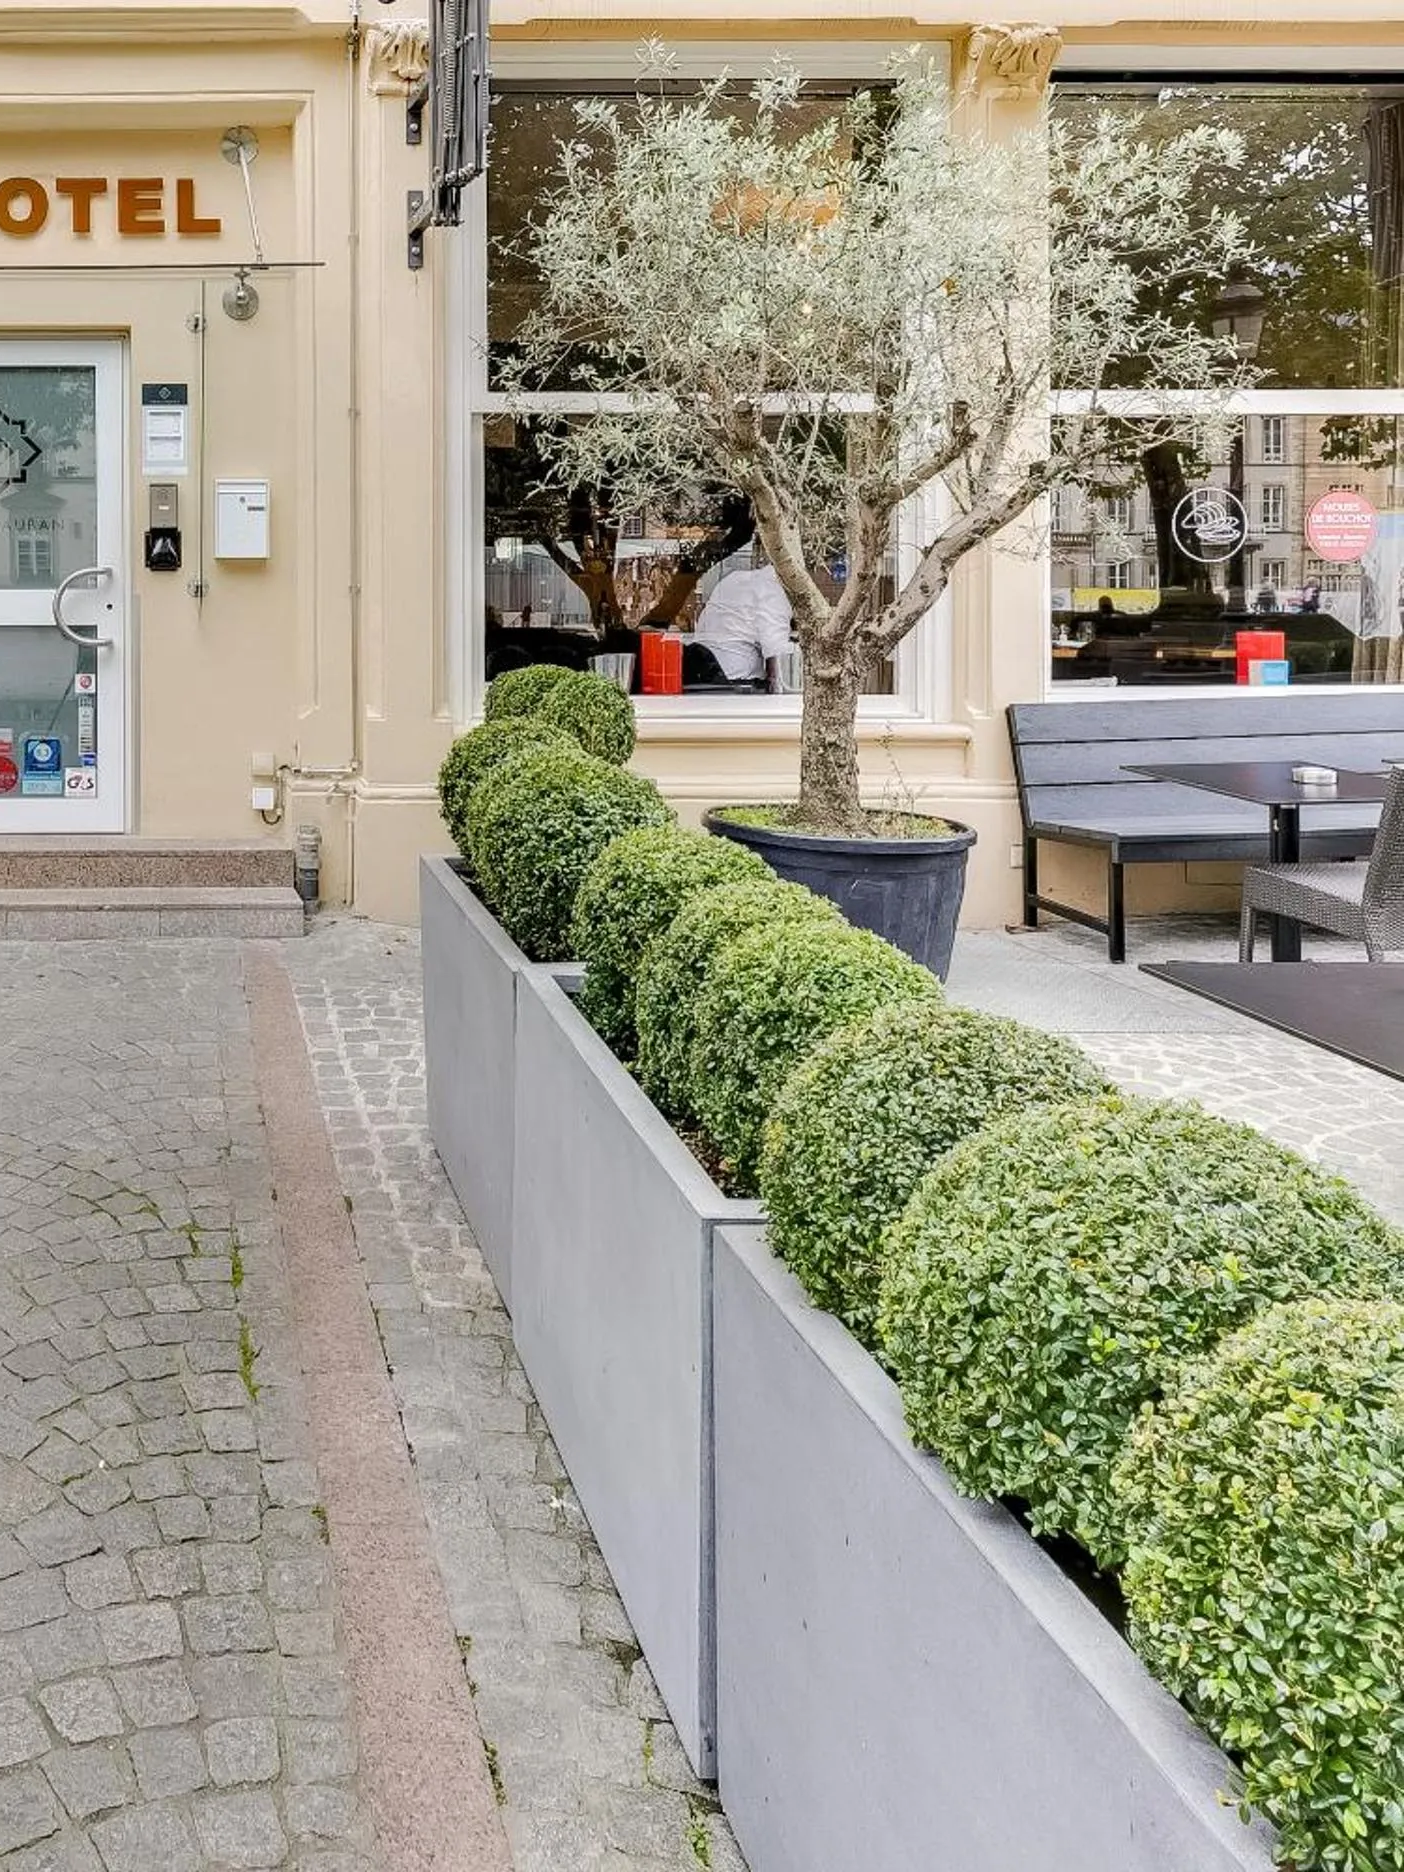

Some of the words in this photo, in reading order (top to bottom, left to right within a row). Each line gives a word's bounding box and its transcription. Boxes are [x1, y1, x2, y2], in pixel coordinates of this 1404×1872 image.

[1322, 503, 1361, 512] MOULES
[1311, 513, 1324, 523] DE
[1327, 513, 1373, 524] BOUCHOT
